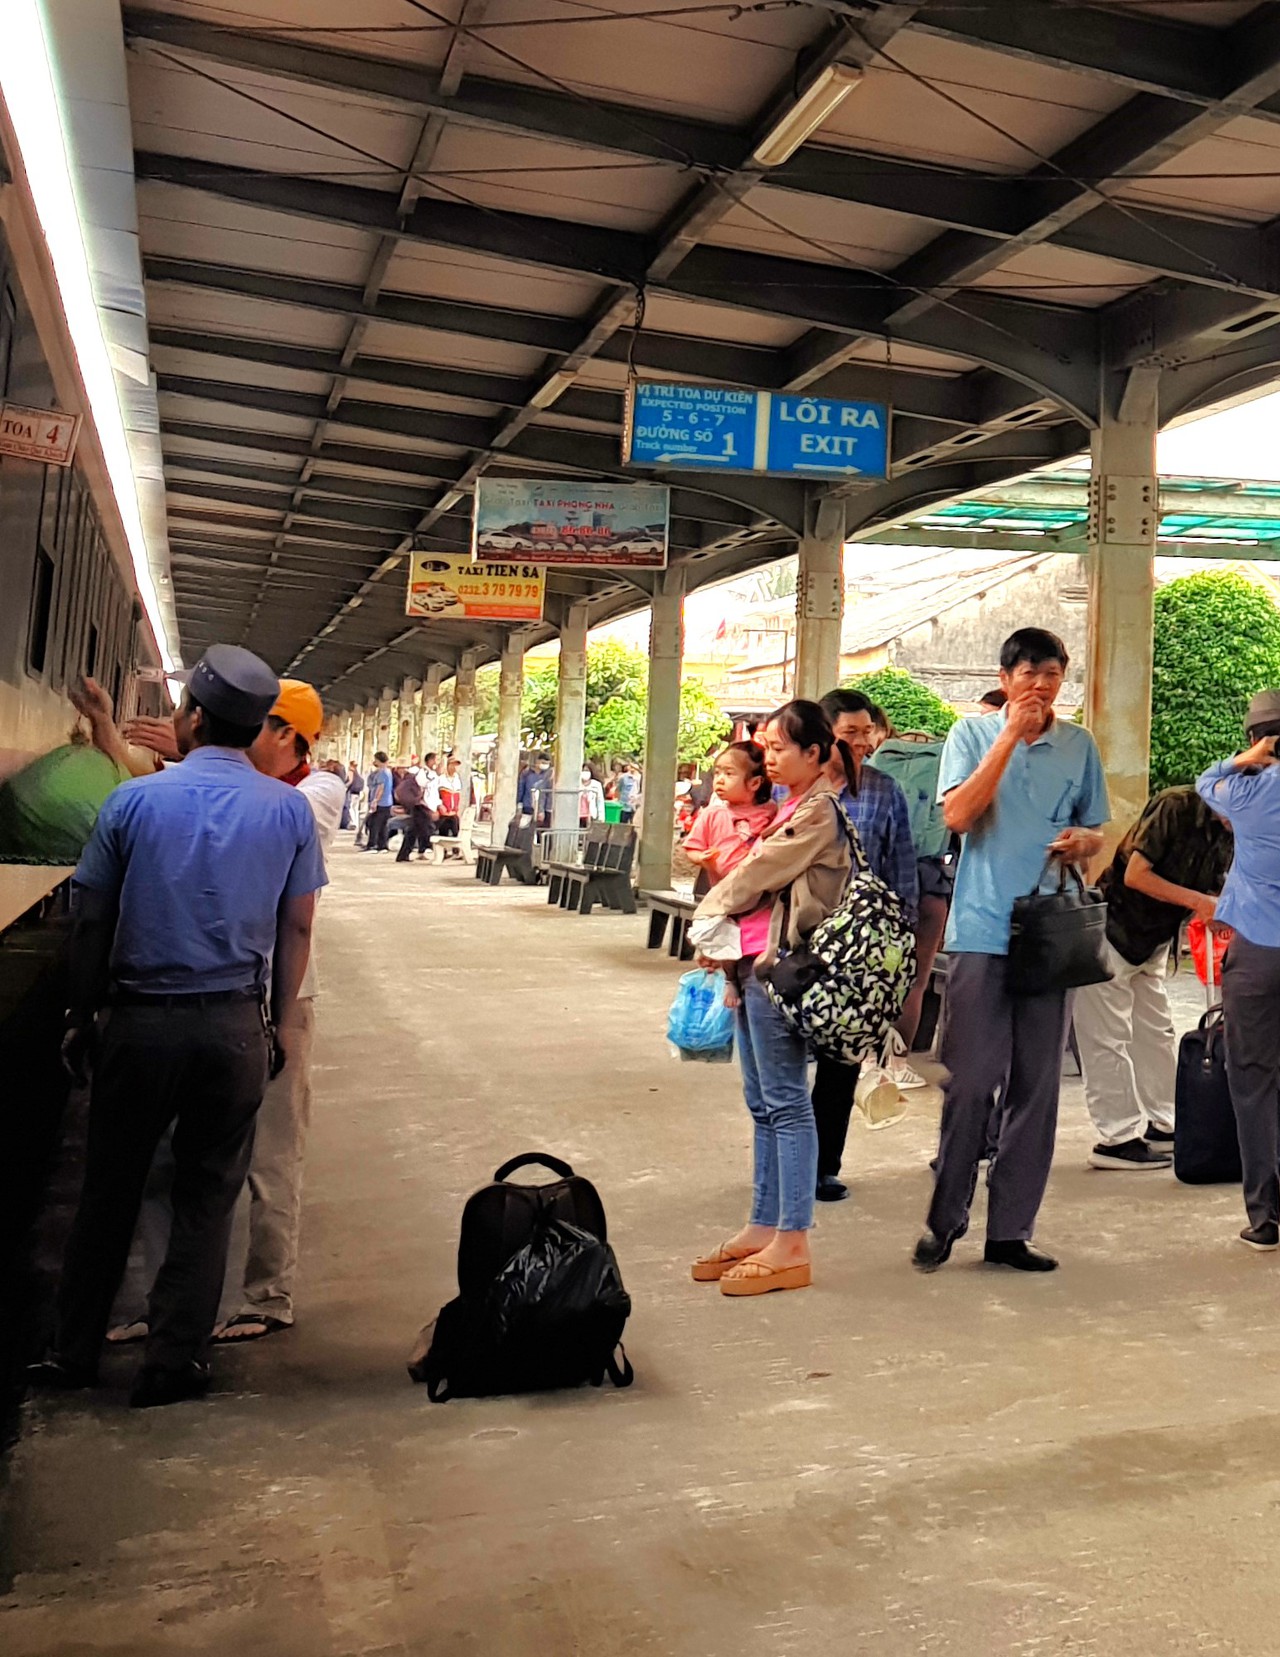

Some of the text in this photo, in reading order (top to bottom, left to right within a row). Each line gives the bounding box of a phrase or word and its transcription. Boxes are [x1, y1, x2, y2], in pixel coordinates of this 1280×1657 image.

[636, 384, 650, 397] VỊ
[653, 383, 675, 398] TRÍ
[677, 388, 701, 400] TOA
[704, 389, 722, 404] DỰ
[641, 397, 747, 415] EXPECTED POSITION
[662, 410, 673, 422] 5
[688, 412, 699, 424] 6
[714, 414, 725, 426] 7
[840, 407, 880, 429] RA
[3, 420, 60, 445] TOA 4
[636, 423, 670, 441] ĐƯỜNG
[721, 431, 738, 456] 1
[636, 439, 698, 452] Track number
[800, 433, 858, 456] EXIT
[533, 499, 555, 508] TAXI
[595, 502, 615, 510] NHA
[457, 566, 483, 576] TAXI
[522, 566, 540, 579] SA
[492, 583, 506, 597] 79
[508, 584, 523, 598] 79
[525, 584, 539, 598] 79
